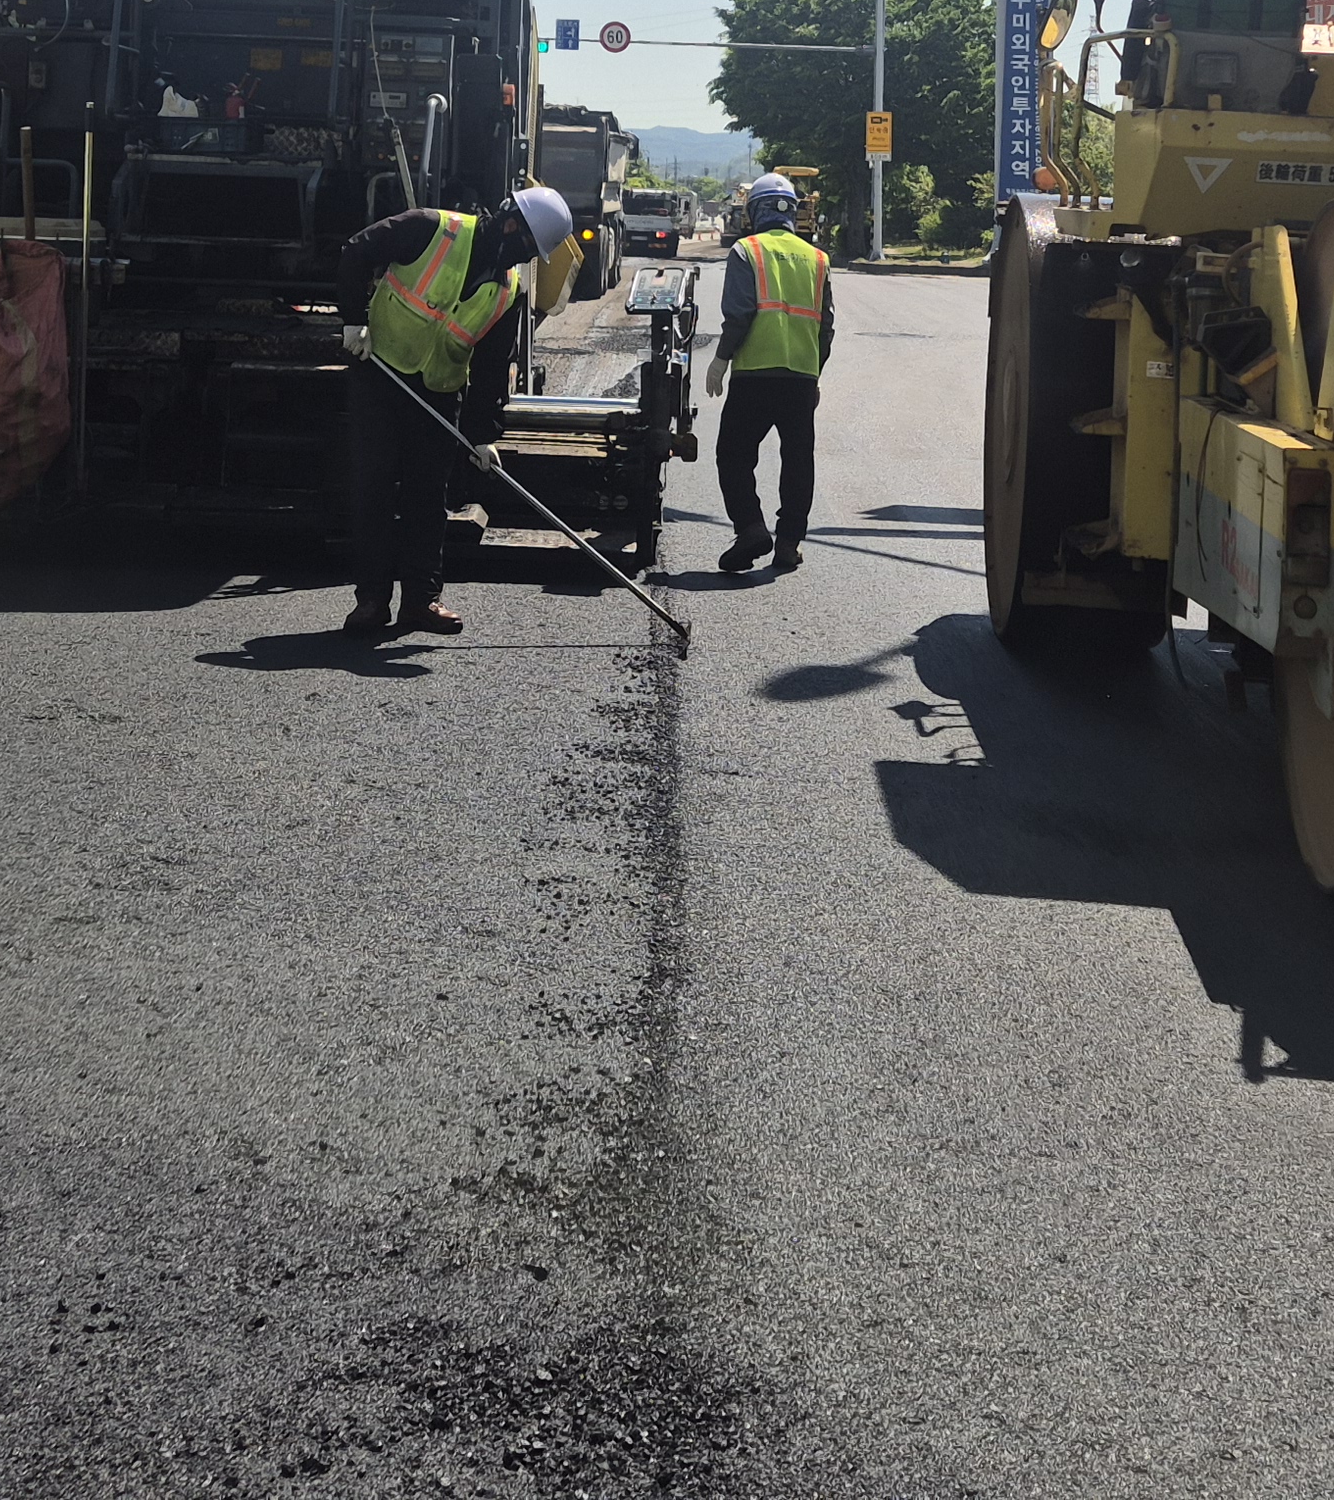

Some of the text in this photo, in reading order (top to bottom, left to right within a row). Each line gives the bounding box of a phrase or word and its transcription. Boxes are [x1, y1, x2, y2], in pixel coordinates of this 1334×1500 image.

[607, 30, 623, 44] 60
[1258, 162, 1324, 183] 後輪荷重
